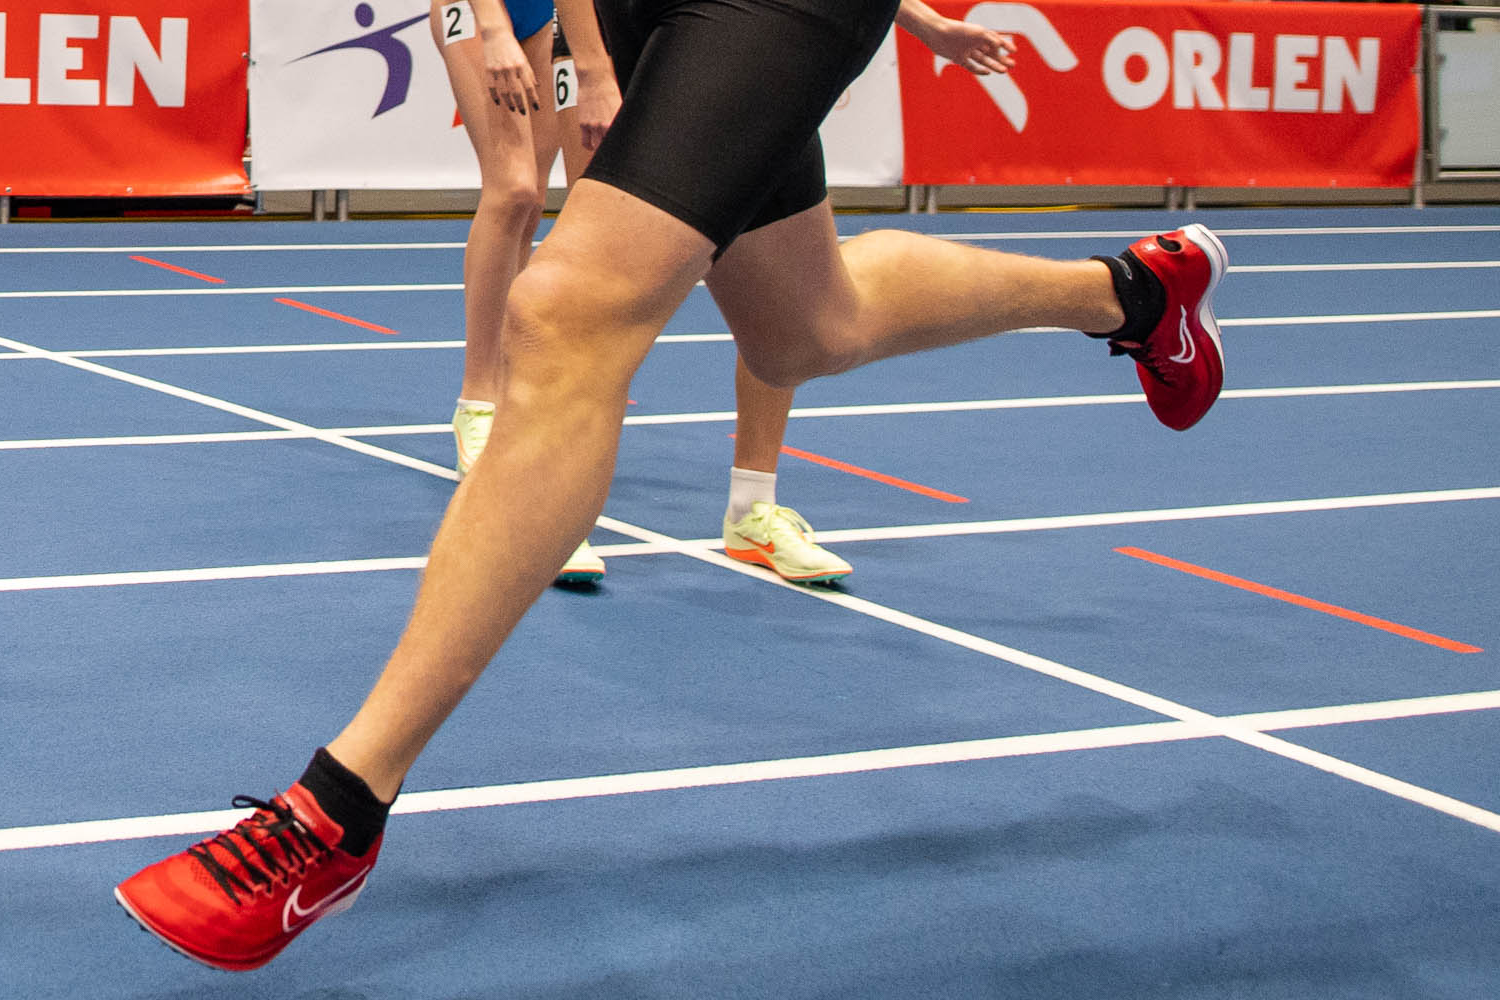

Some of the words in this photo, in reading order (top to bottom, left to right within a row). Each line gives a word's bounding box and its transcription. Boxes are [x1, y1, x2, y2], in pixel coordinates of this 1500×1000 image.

[446, 6, 463, 38] 2
[555, 67, 570, 106] 6
[1102, 26, 1381, 114] ORLEN
